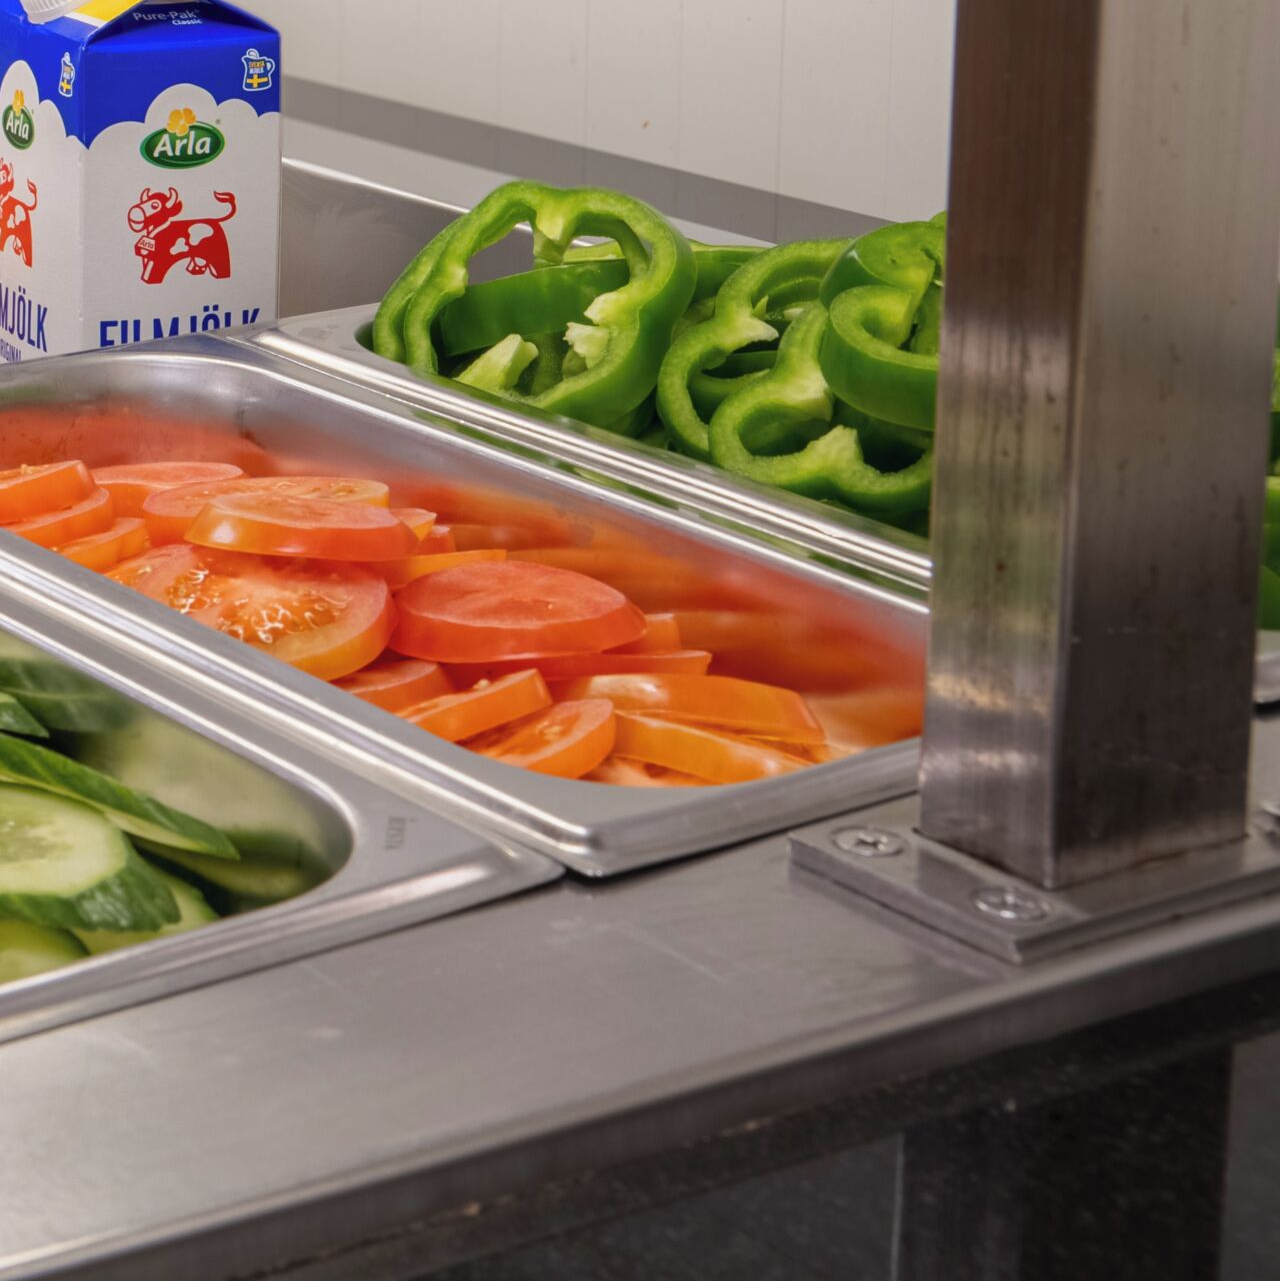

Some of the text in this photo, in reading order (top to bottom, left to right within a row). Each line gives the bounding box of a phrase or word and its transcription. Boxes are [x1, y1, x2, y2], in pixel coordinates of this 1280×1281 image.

[171, 18, 203, 26] Classic
[5, 114, 30, 140] Arla
[153, 130, 211, 158] Arla
[140, 239, 154, 250] Arla
